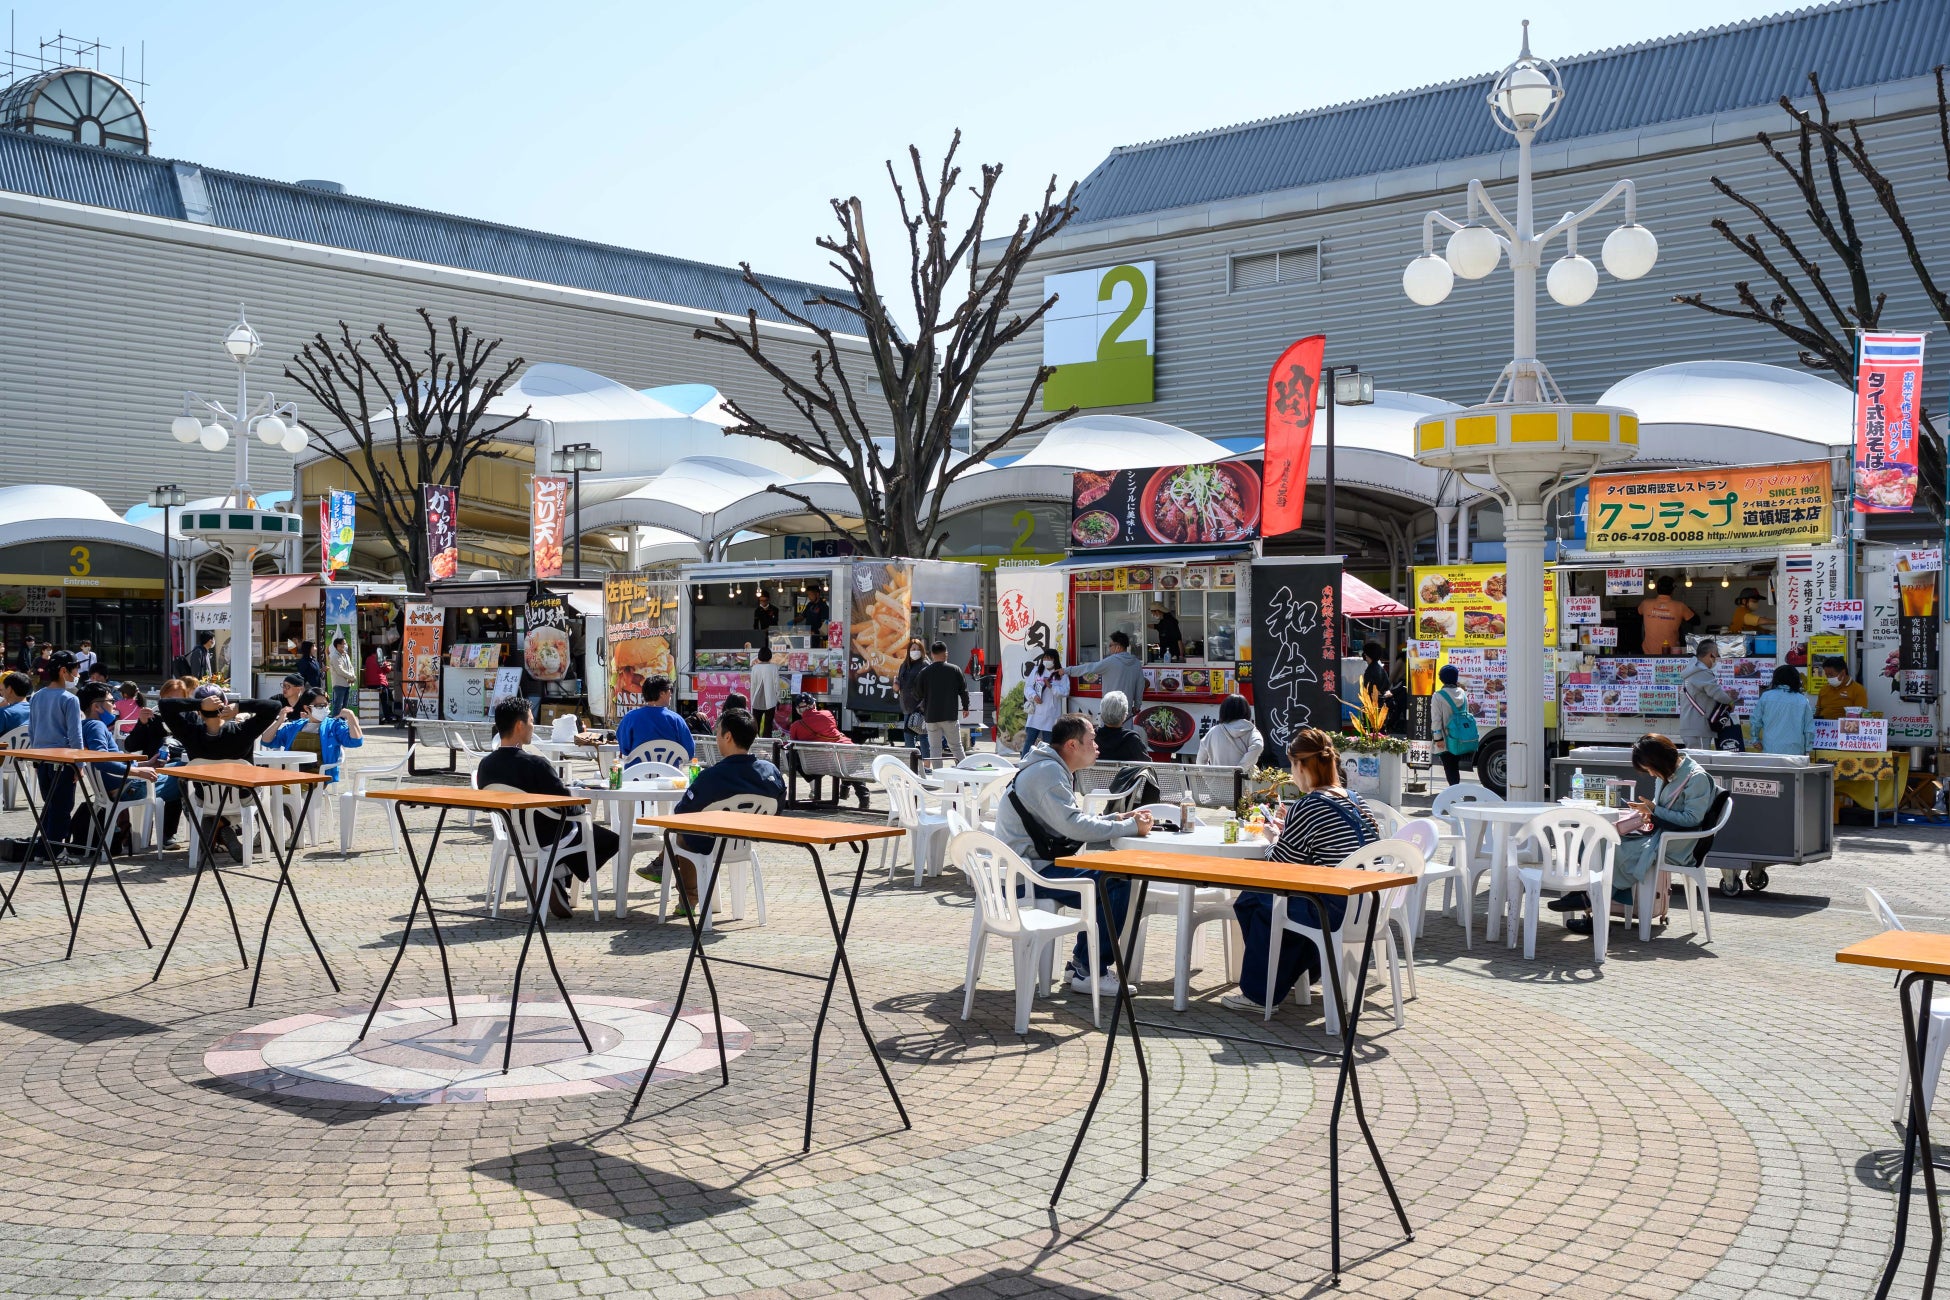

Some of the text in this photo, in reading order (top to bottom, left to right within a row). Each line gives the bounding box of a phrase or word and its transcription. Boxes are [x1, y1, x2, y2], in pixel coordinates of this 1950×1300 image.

[1097, 264, 1148, 361] 2
[1865, 372, 1886, 469] タイ式焼そば
[1607, 481, 1727, 495] タイ国政府認定レストラン
[1769, 486, 1820, 498] SINCE 1992
[341, 494, 352, 526] 北海道
[1125, 470, 1136, 542] シンプルに美味しい
[1742, 496, 1822, 508] タイ料理とタイスキの店
[428, 490, 456, 549] からあげ
[534, 481, 556, 545] とり天
[1743, 506, 1822, 526] 道頓堀本店
[1011, 510, 1035, 554] 2
[1209, 525, 1254, 538] ステーキ丼
[1611, 524, 1819, 542] 06-4708-0088 http://www.krungtep.co.jp
[69, 545, 91, 576] 3
[999, 558, 1040, 568] Entrance
[1911, 551, 1939, 560] 生ビール
[1927, 561, 1941, 569] 500円
[63, 577, 99, 586] Entrance
[1607, 569, 1643, 578] 料理お渡し口
[606, 577, 648, 604] 佐世保
[1788, 575, 1799, 610] ただ今
[618, 596, 678, 622] バーガー
[1803, 580, 1813, 632] 本格タイ料理
[1823, 601, 1863, 611] ご注文口
[532, 605, 569, 629] とり天丼
[1592, 627, 1615, 636] 生ビール
[1212, 671, 1221, 691] 生ビール
[1905, 681, 1934, 695] 樽生
[1410, 750, 1430, 763] 樽生
[1739, 781, 1772, 789] もえるごみ
